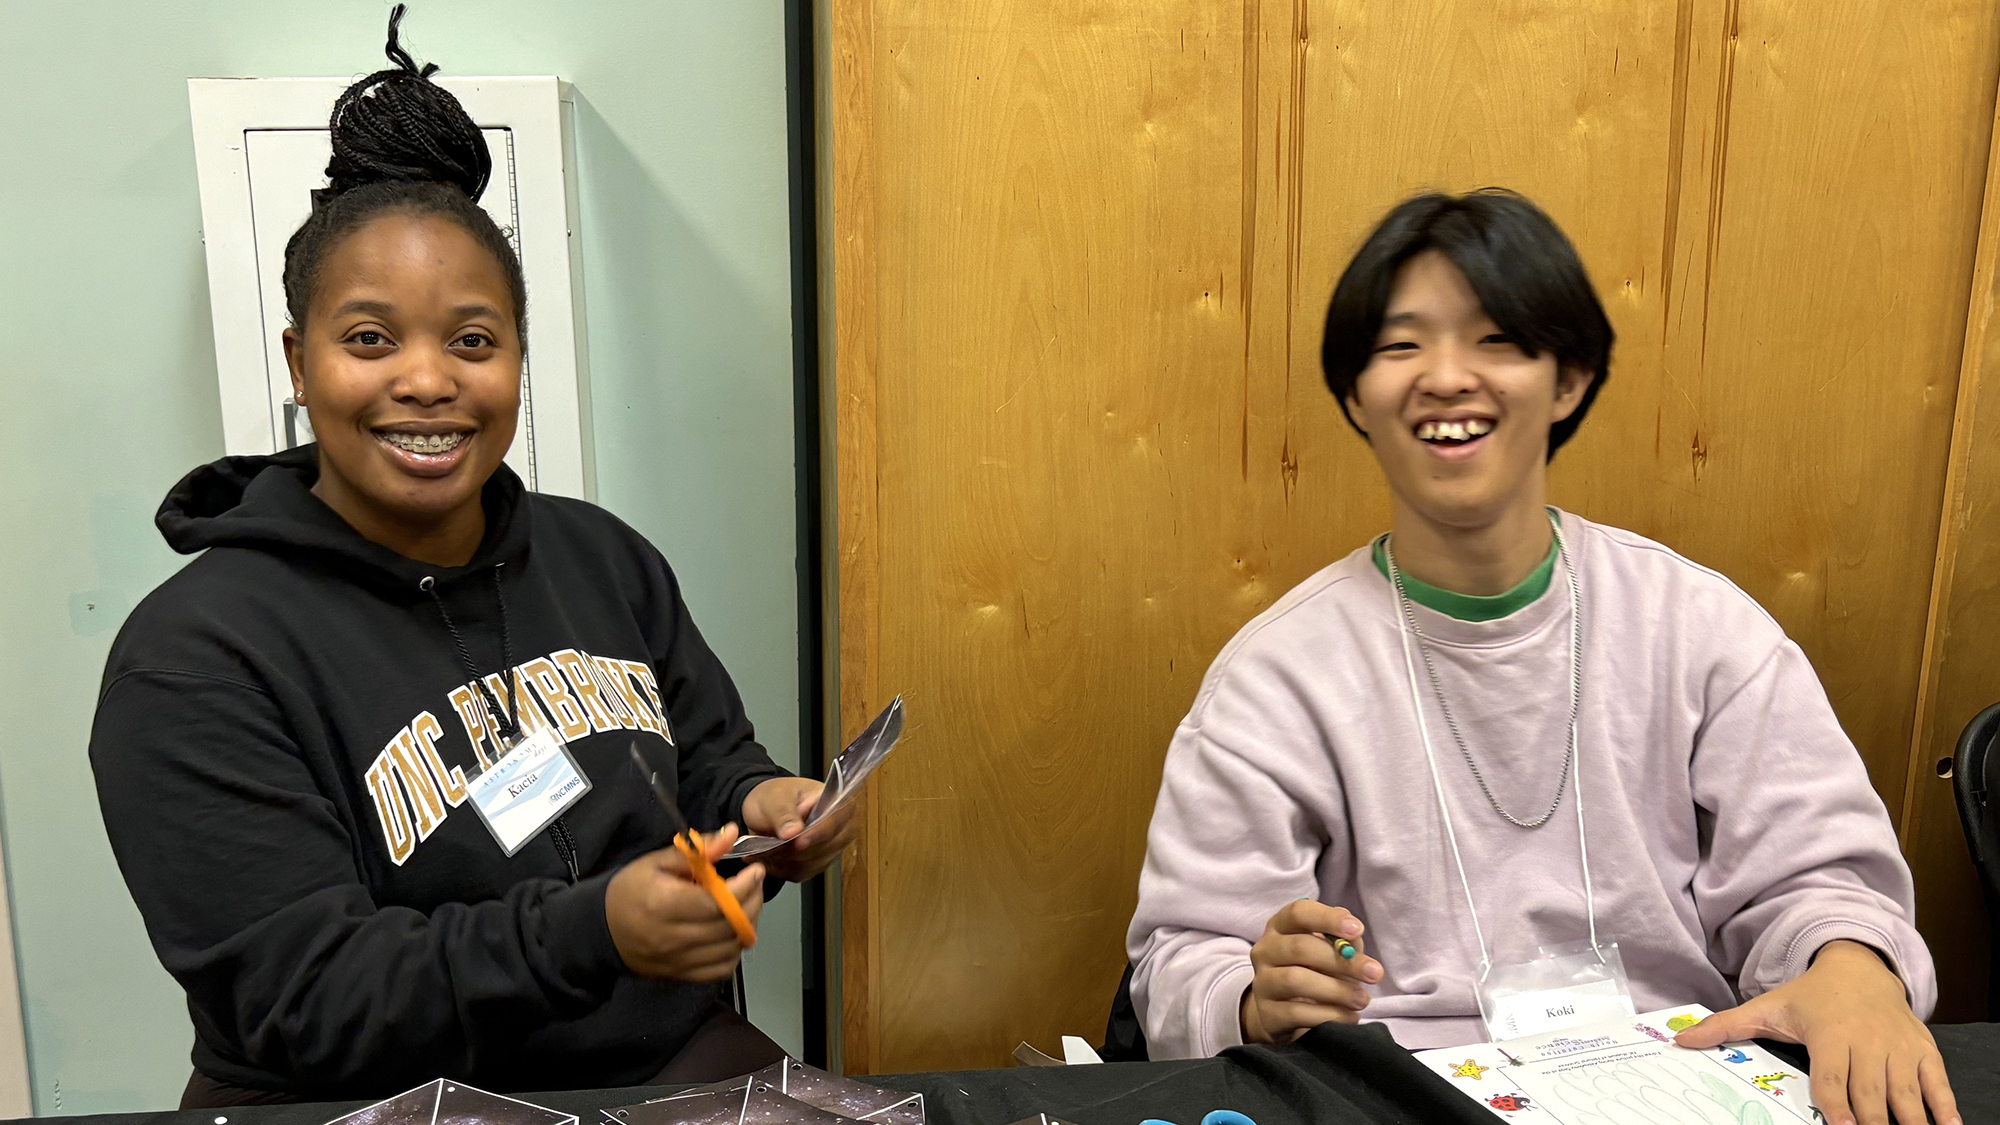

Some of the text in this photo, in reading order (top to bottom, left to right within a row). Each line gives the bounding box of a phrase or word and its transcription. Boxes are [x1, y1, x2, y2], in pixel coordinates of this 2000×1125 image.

[364, 648, 676, 867] UNC PEMBROKE
[508, 773, 539, 799] Kacia
[1545, 1005, 1576, 1018] Koki
